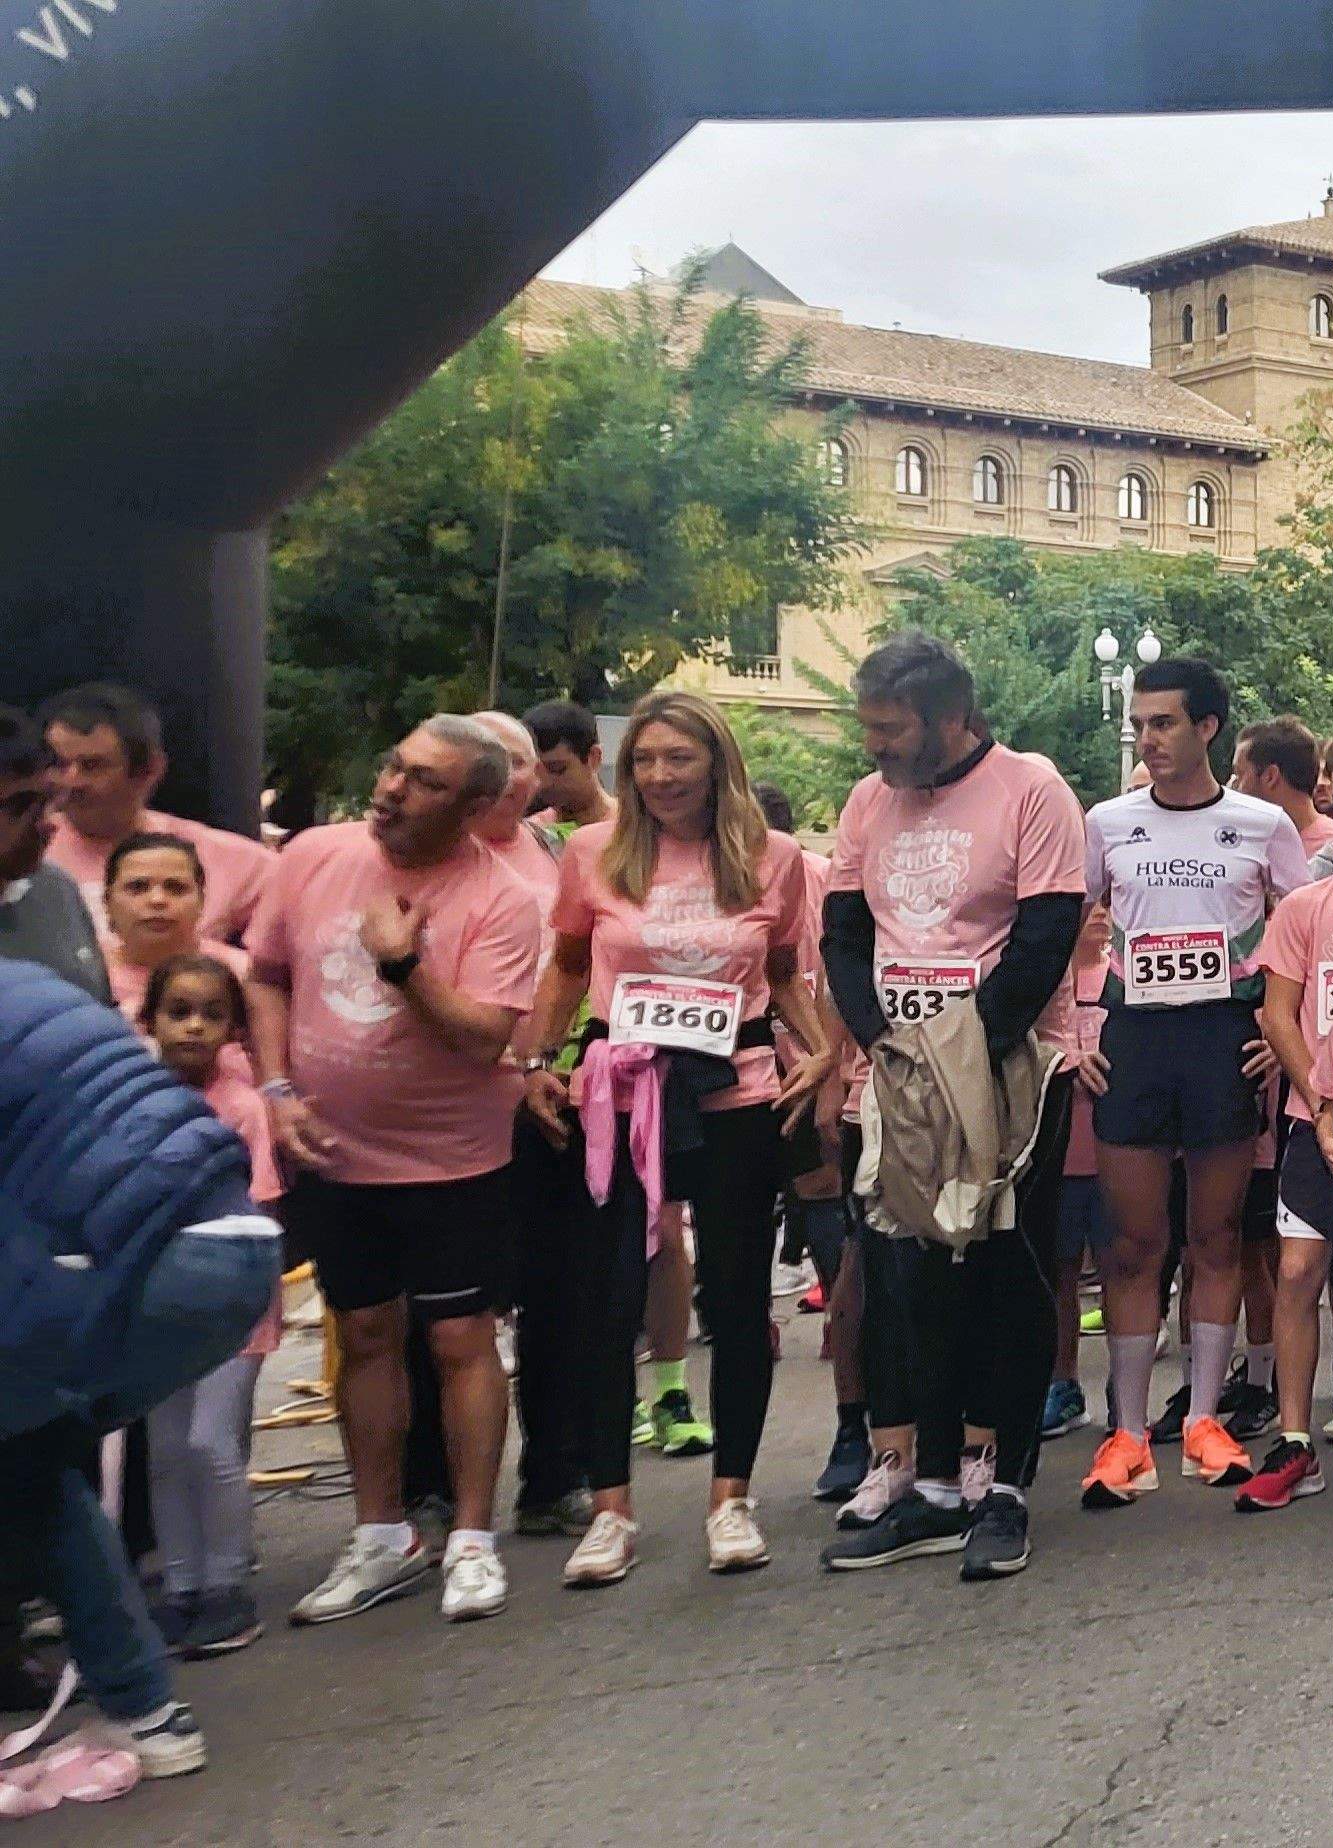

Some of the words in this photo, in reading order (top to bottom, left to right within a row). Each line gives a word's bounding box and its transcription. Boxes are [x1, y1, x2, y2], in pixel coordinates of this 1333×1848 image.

[1135, 943, 1170, 951] CONTRA
[1171, 941, 1181, 949] EL
[1184, 938, 1219, 948] CÁNCER
[1135, 951, 1222, 984] 3559
[626, 1000, 728, 1033] 1860
